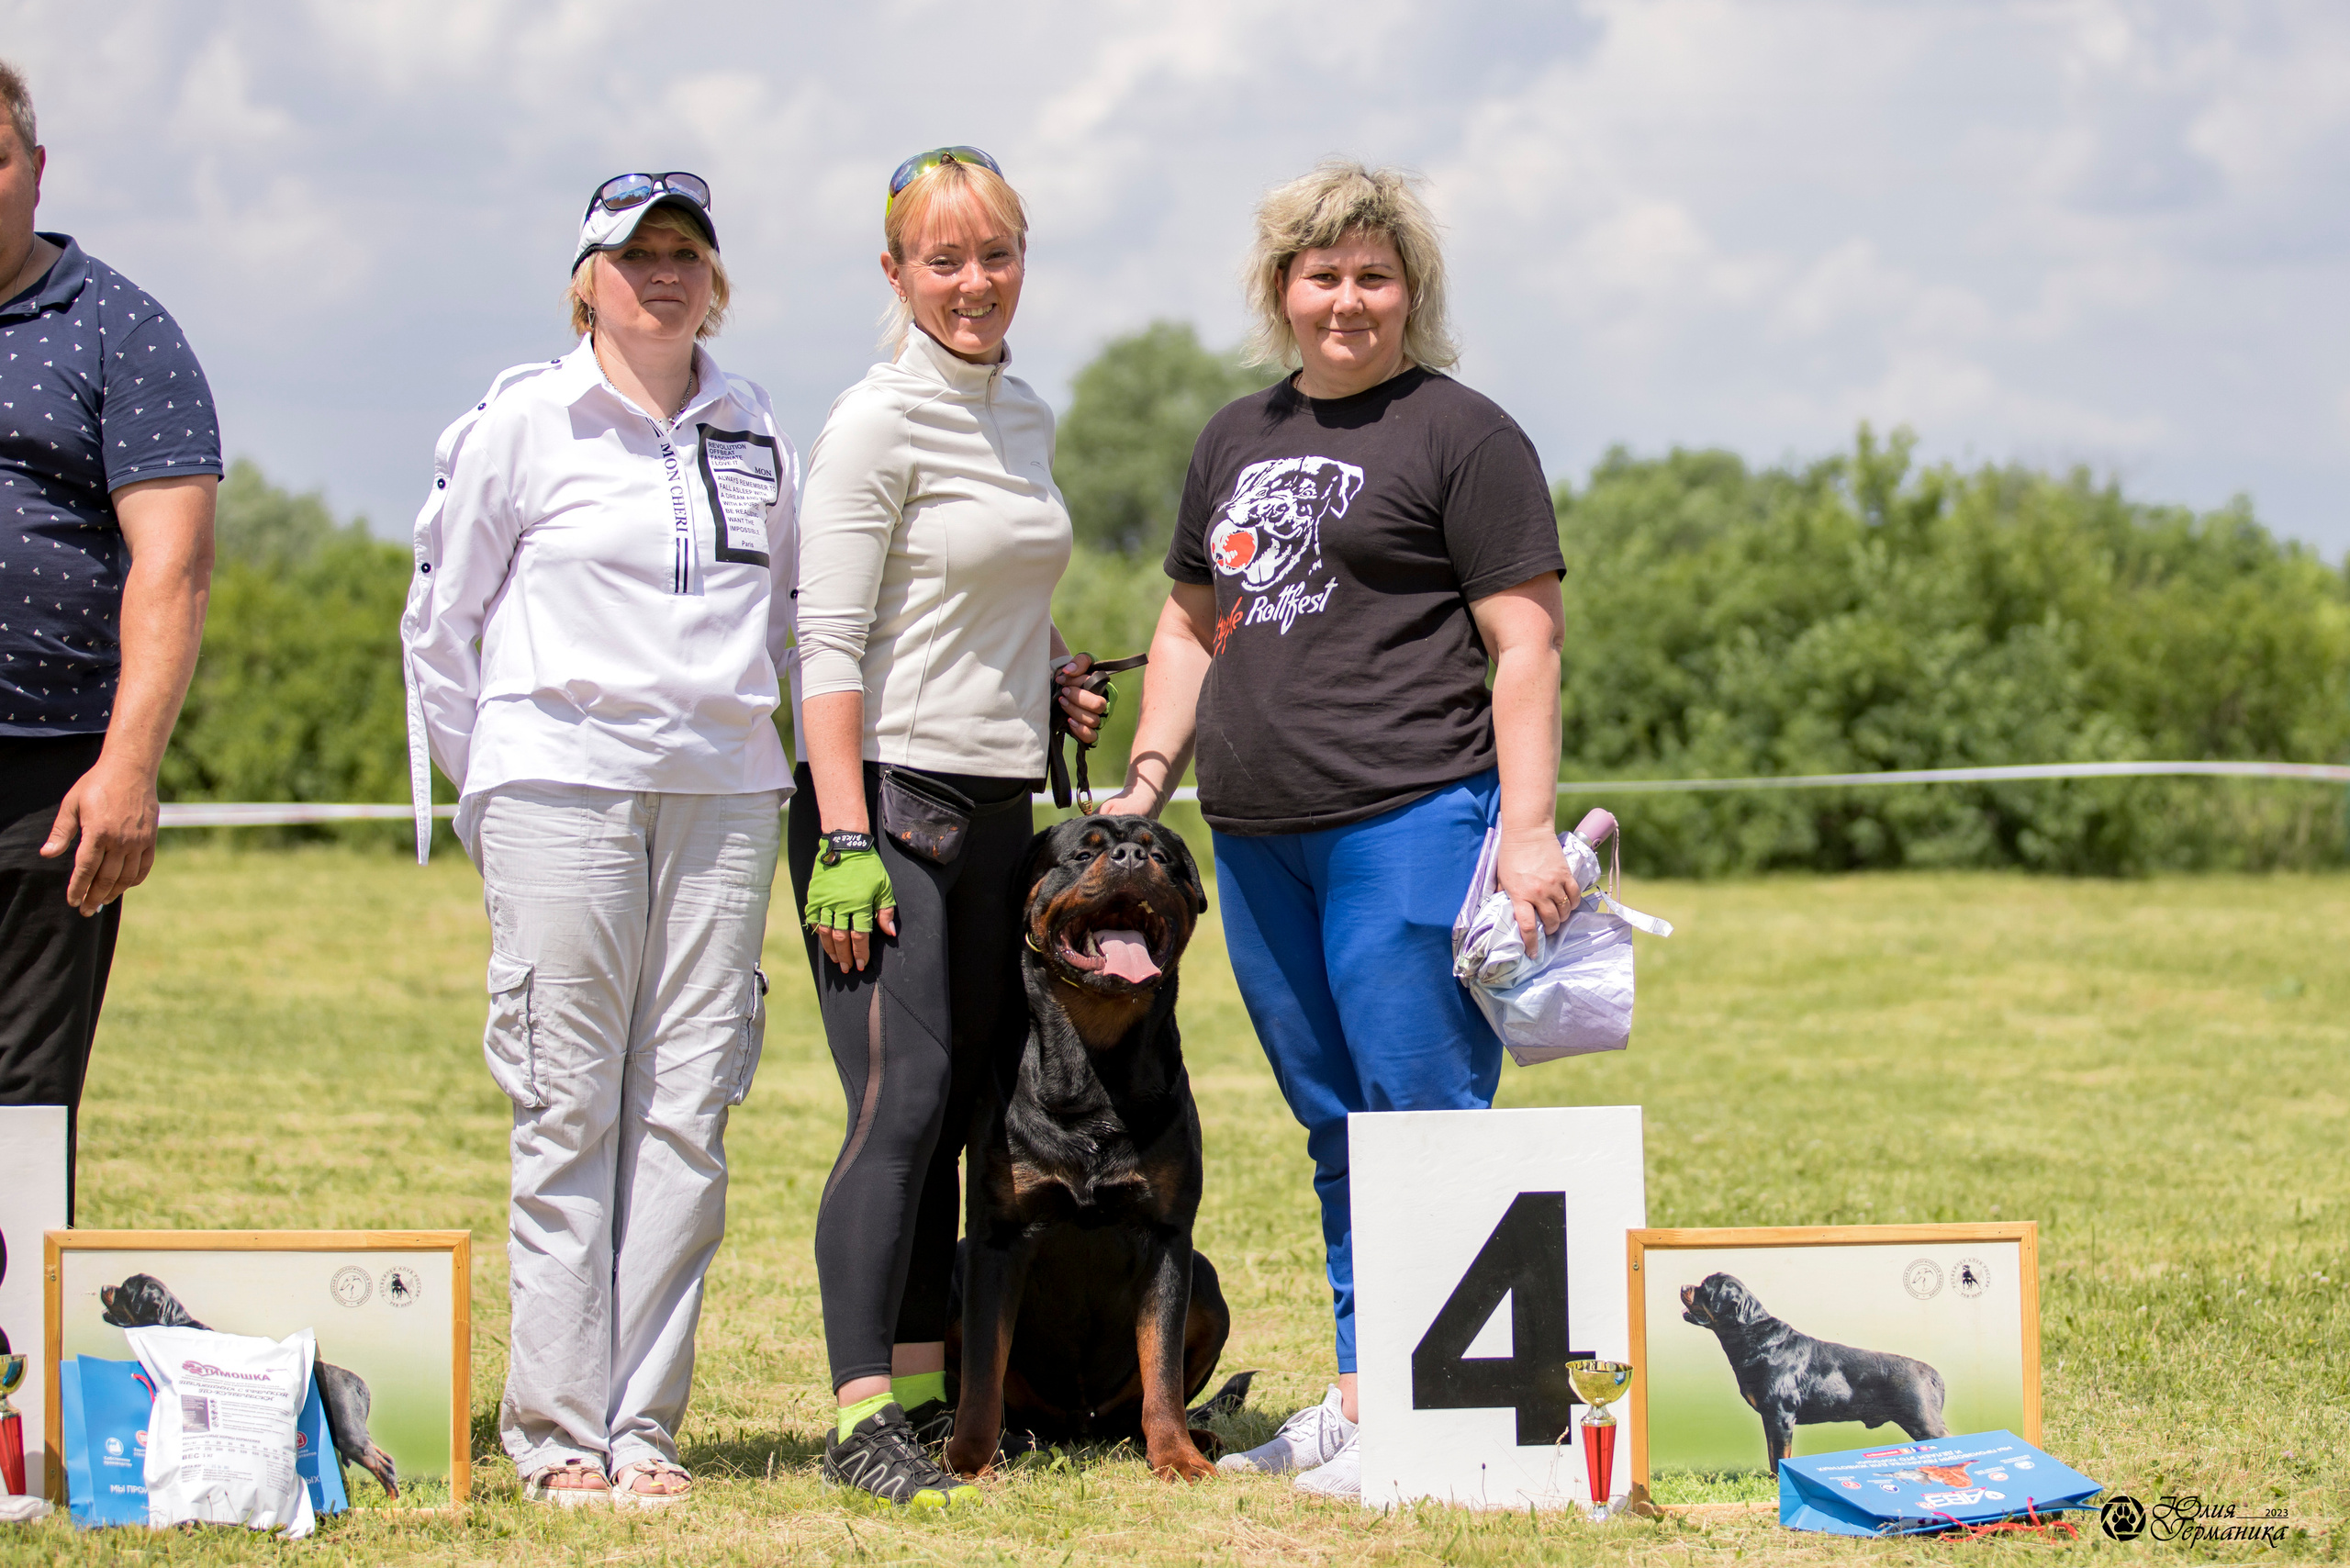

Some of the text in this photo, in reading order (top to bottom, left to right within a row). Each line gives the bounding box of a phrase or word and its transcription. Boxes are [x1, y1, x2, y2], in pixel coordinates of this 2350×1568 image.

[708, 442, 746, 451] REVOLUTION
[755, 466, 772, 476] MON
[660, 442, 688, 532] MON CHERI
[718, 475, 739, 485] ALWAYS
[739, 478, 768, 491] REMEMBER
[719, 483, 732, 491] FALL
[742, 540, 755, 548] Paris
[1412, 1191, 1596, 1446] 4
[110, 1484, 125, 1494] МЫ
